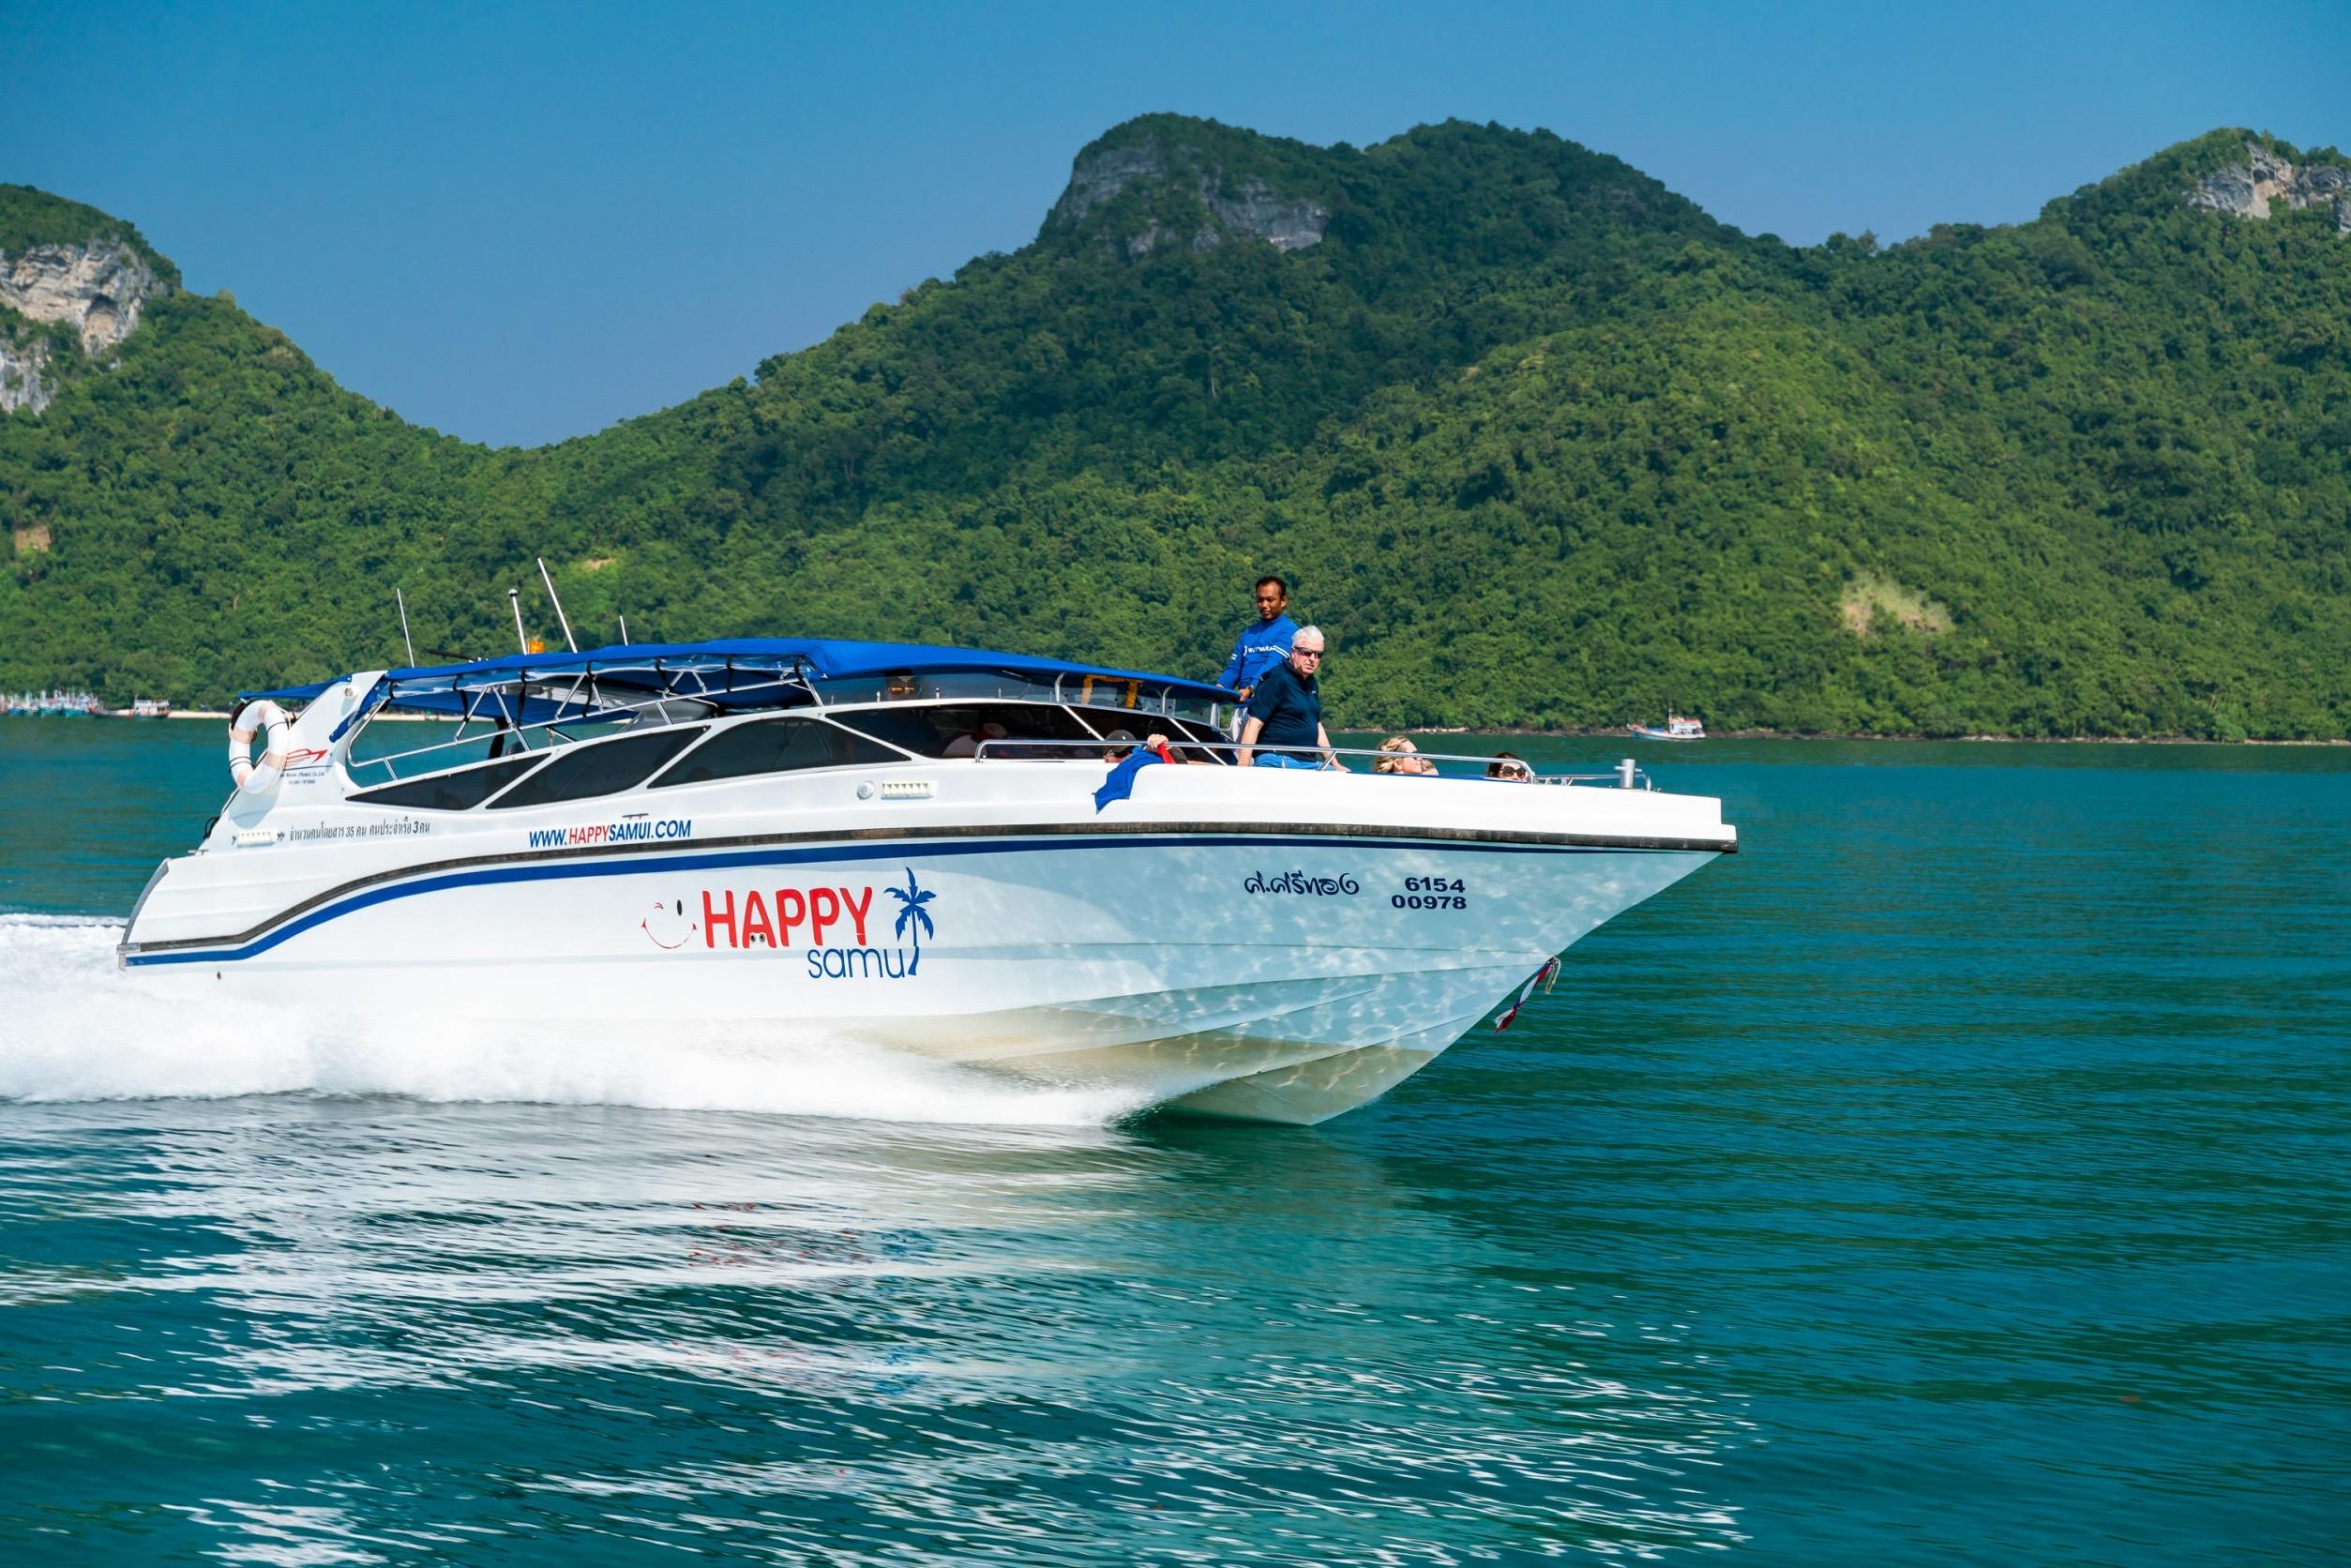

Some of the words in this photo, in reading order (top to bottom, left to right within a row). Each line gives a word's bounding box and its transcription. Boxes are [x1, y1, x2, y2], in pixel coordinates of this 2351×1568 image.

[346, 826, 354, 837] 35
[529, 820, 692, 848] WWW.HAPPYSAMUI.COM
[1405, 877, 1466, 893] 6154
[1391, 895, 1468, 909] 00978
[701, 886, 873, 948] HAPPY
